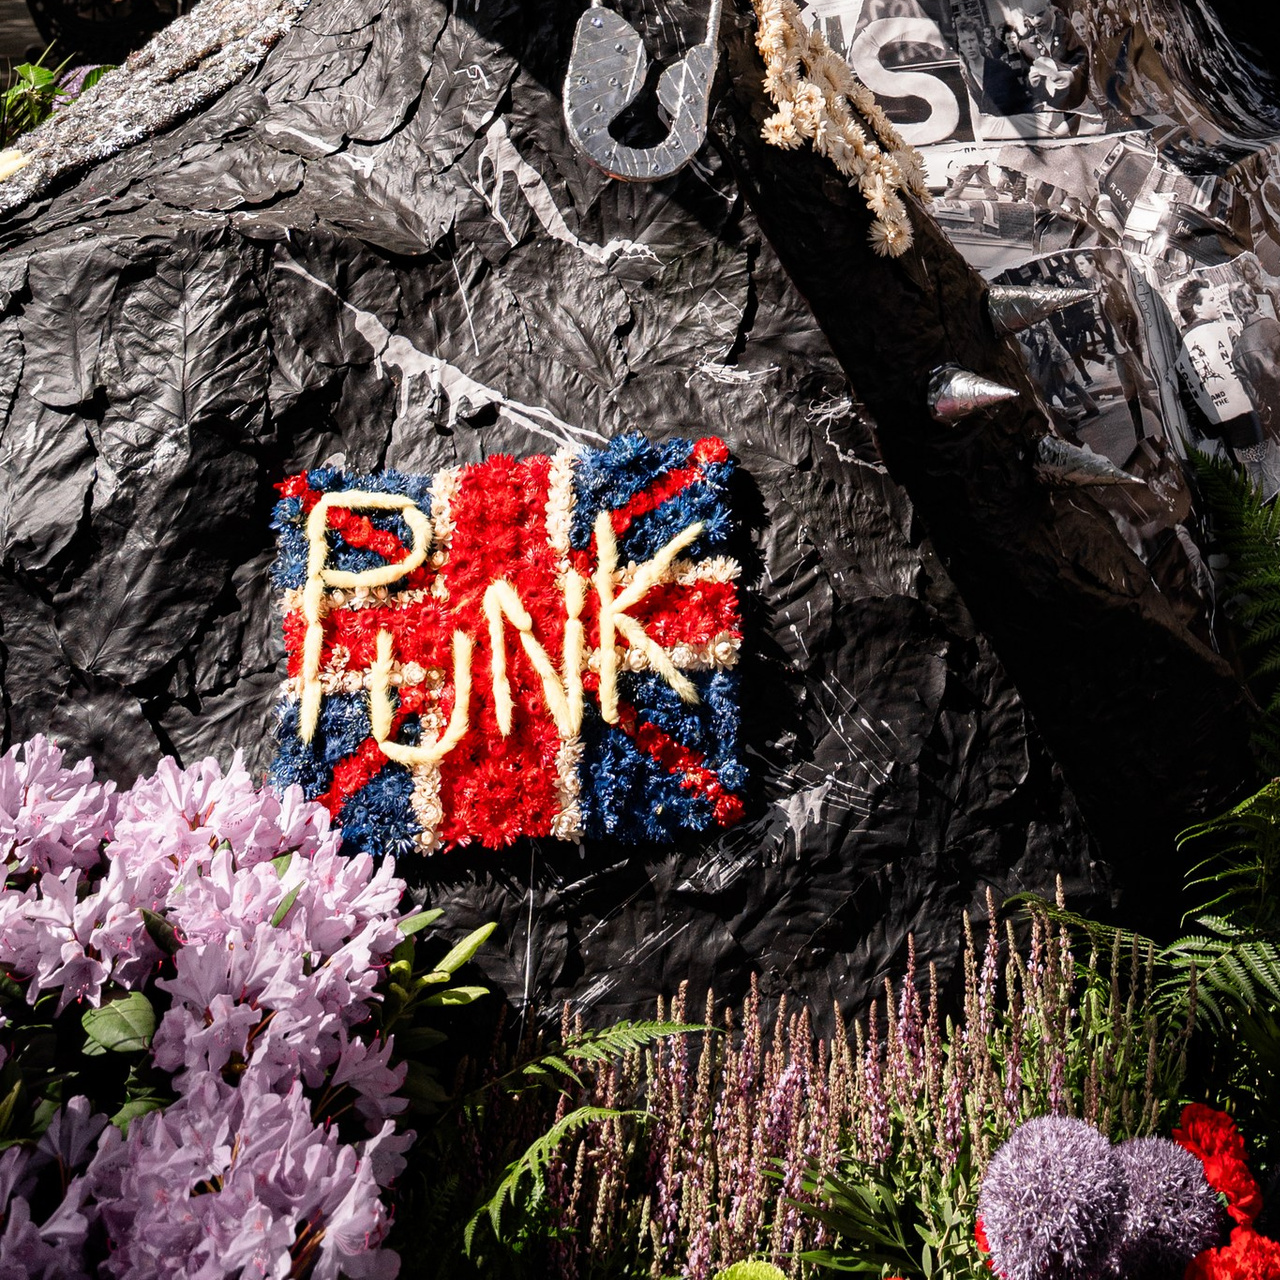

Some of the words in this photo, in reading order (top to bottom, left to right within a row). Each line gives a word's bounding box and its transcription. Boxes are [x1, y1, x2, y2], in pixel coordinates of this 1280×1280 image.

[1108, 181, 1132, 210] ROVE
[1210, 390, 1227, 401] AND
[1214, 398, 1230, 406] THE
[300, 490, 702, 765] PUNK
